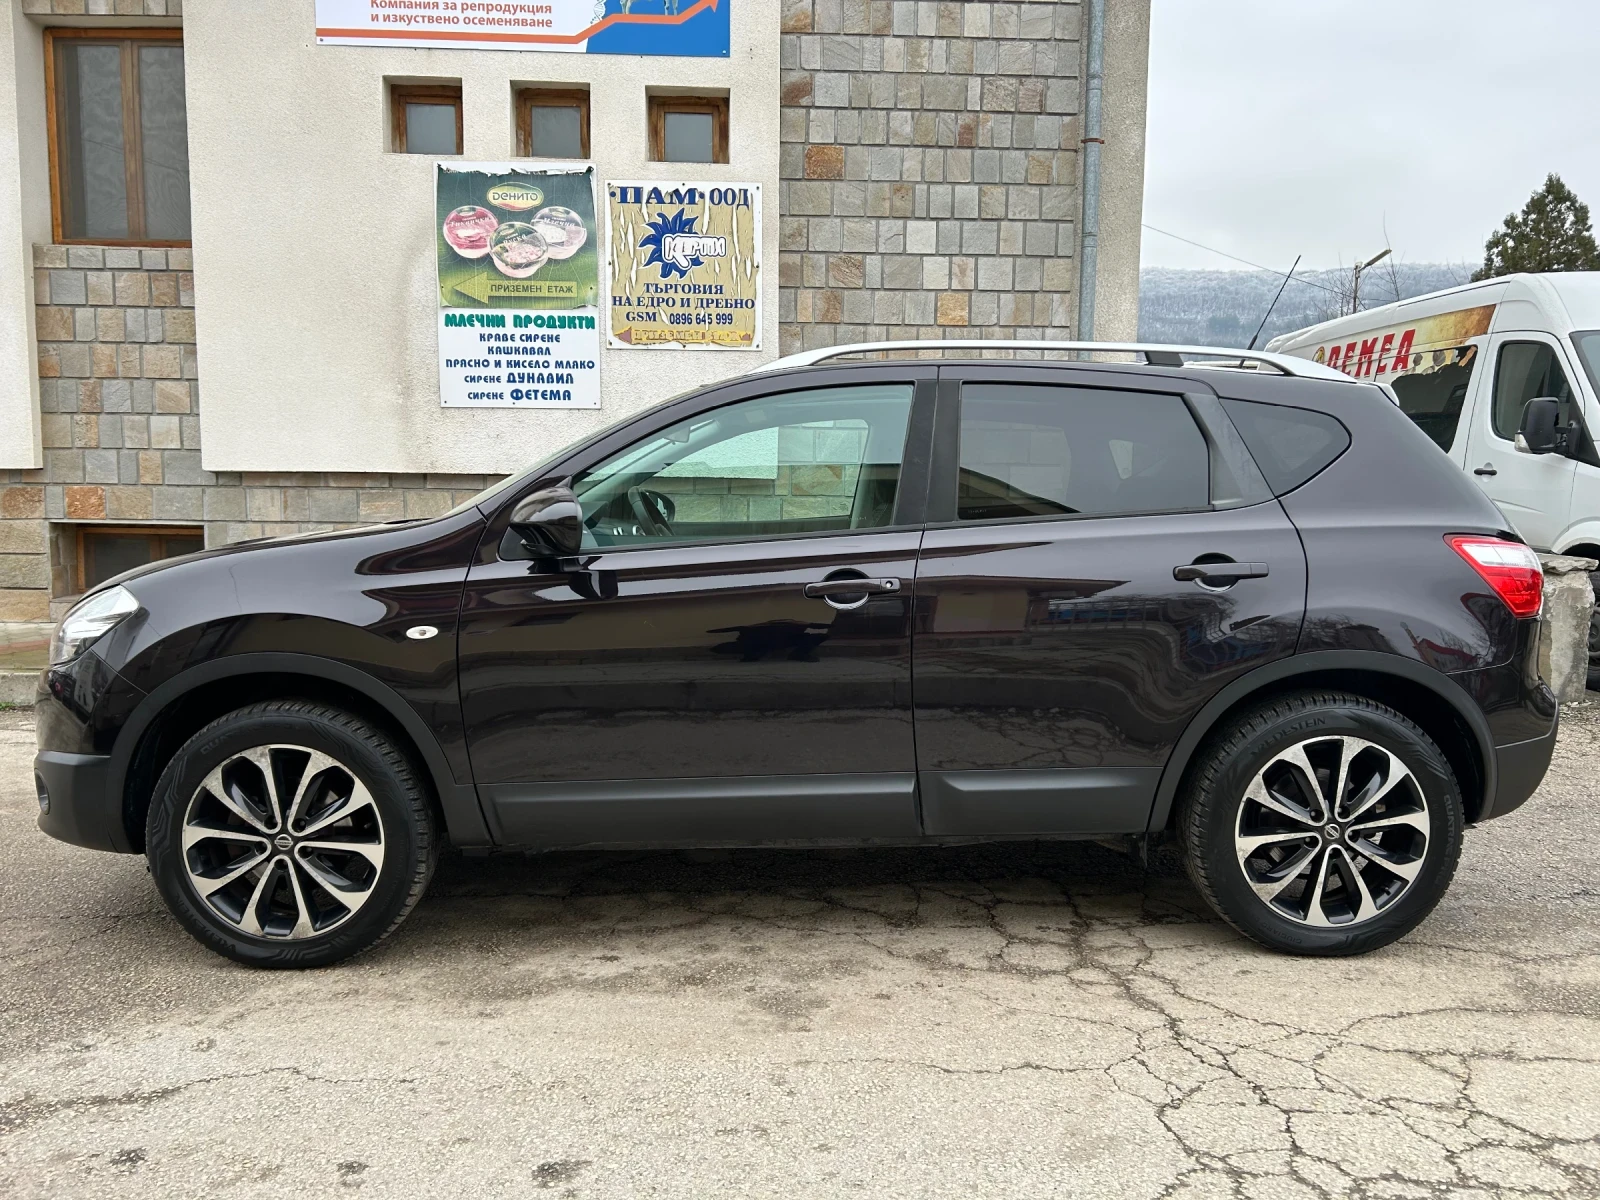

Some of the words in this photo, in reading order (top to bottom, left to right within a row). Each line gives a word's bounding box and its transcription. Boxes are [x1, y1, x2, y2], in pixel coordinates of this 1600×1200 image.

[370, 0, 439, 10] Компания
[442, 0, 457, 11] за
[460, 2, 552, 15] репродукция
[370, 13, 379, 22] и
[382, 13, 460, 26] изкуствено
[463, 15, 552, 28] осеменяване
[617, 186, 699, 205] ПАМ
[709, 187, 750, 211] ООД
[490, 284, 542, 293] ПРИЗЕМЕН
[547, 285, 574, 294] ЕТАЖ
[643, 282, 724, 295] ТЪРГОВИЯ
[612, 295, 632, 307] НА
[635, 296, 676, 309] ЕДРО
[680, 297, 691, 308] И
[694, 298, 755, 310] ДРЕБНО
[444, 313, 506, 328] МЛЕЧНИ
[512, 314, 596, 330] ПРОДУКТИ
[625, 311, 657, 322] GSM
[669, 312, 692, 325] 0896
[715, 313, 733, 325] 999
[479, 332, 516, 342] КРАВЕ
[519, 333, 561, 343] СИРЕНЕ
[487, 345, 552, 356] КАШКАВАЛ
[445, 358, 490, 368] ПРЯСНО
[494, 359, 502, 369] И
[506, 359, 550, 369] КИСЕЛО
[554, 360, 595, 370] МЛЯКО
[464, 375, 502, 384] СИРЕНЕ
[467, 391, 504, 400] СИРЕНЕ
[510, 388, 572, 401] ФЕТЕМА
